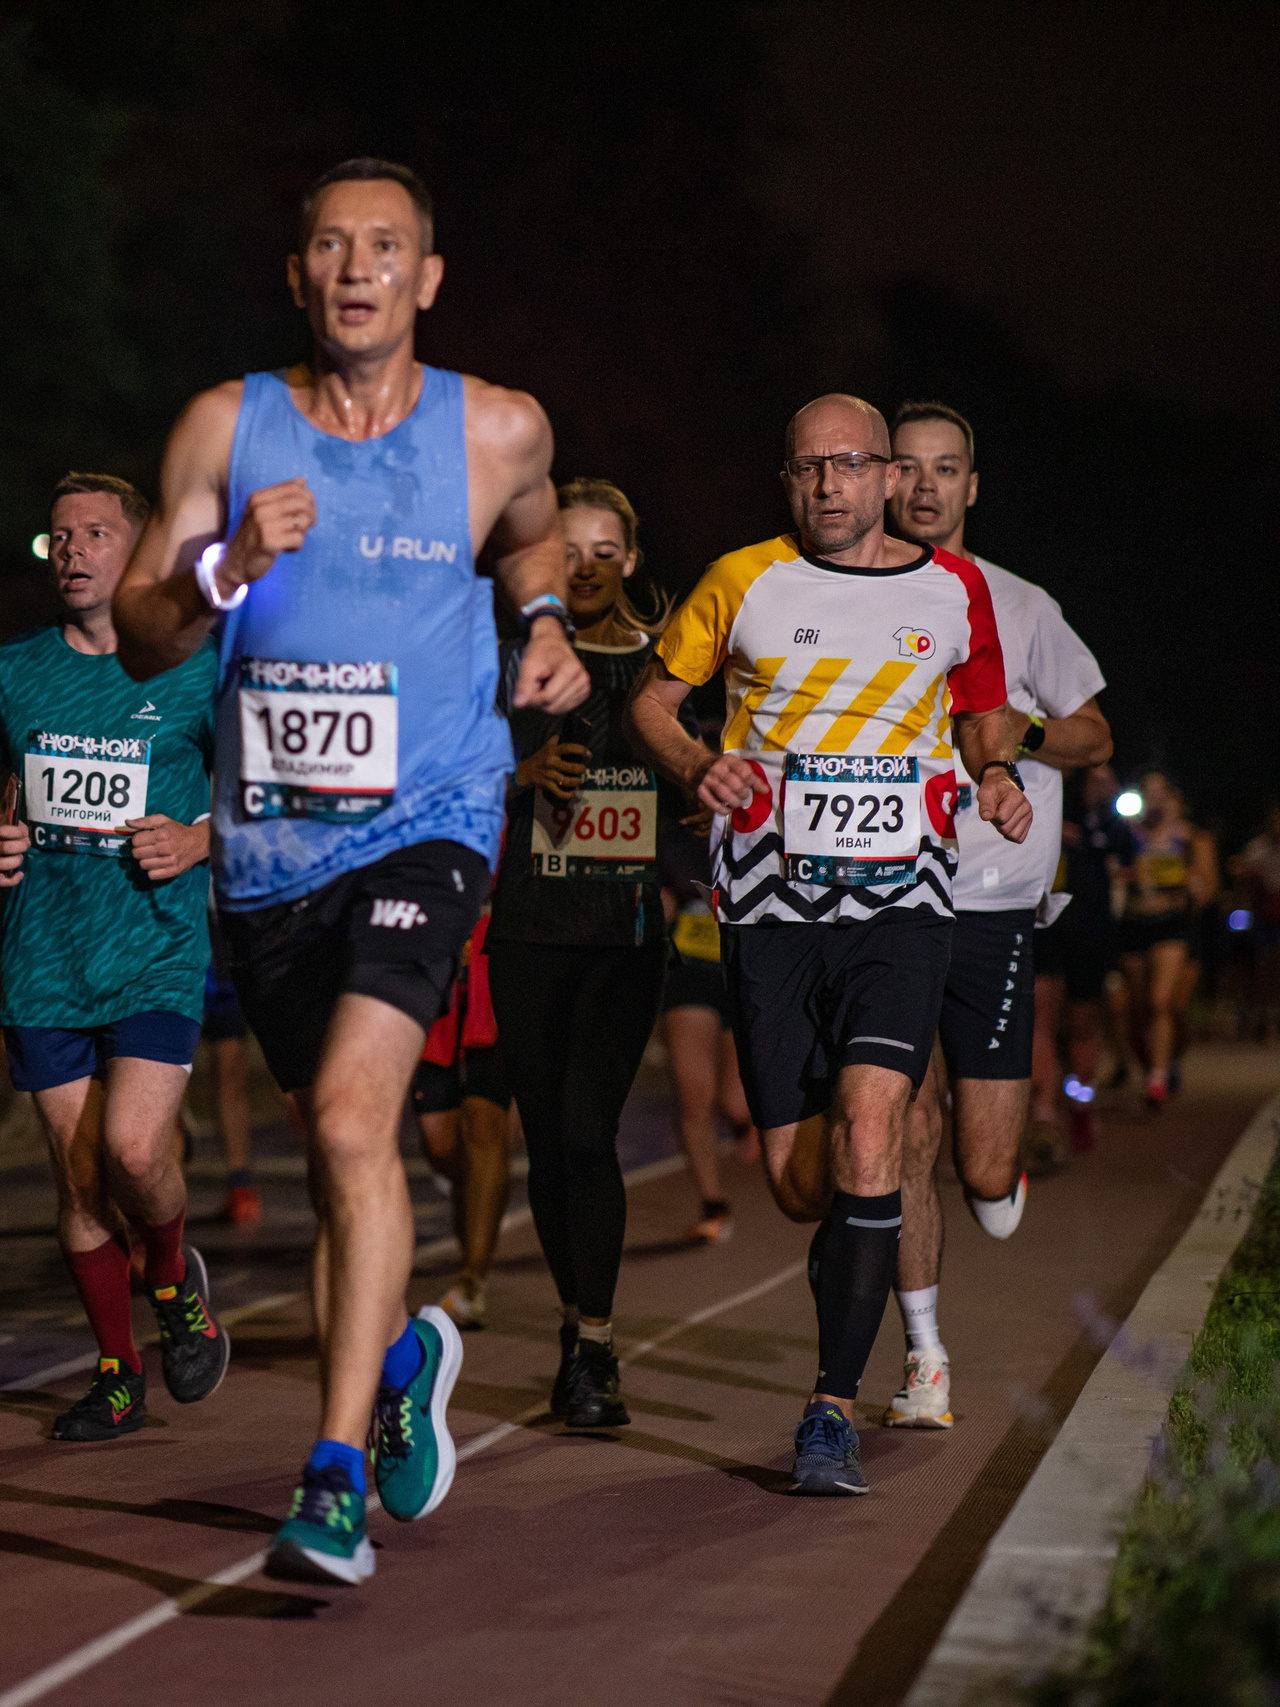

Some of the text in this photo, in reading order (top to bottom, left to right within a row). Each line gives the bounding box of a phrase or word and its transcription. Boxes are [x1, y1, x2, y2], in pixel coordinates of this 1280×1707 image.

[392, 537, 457, 564] RUN
[793, 627, 820, 645] GRi
[38, 730, 141, 758] НОЧНОЙ
[257, 706, 373, 757] 1870
[581, 767, 649, 786] ЧНОЙ
[801, 755, 910, 777] НОЧНОЙ
[41, 766, 131, 809] 1208
[51, 806, 111, 822] ГРИГОРИЙ
[551, 806, 641, 842] 9603
[803, 793, 904, 833] 7923
[835, 837, 872, 848] ИВАН
